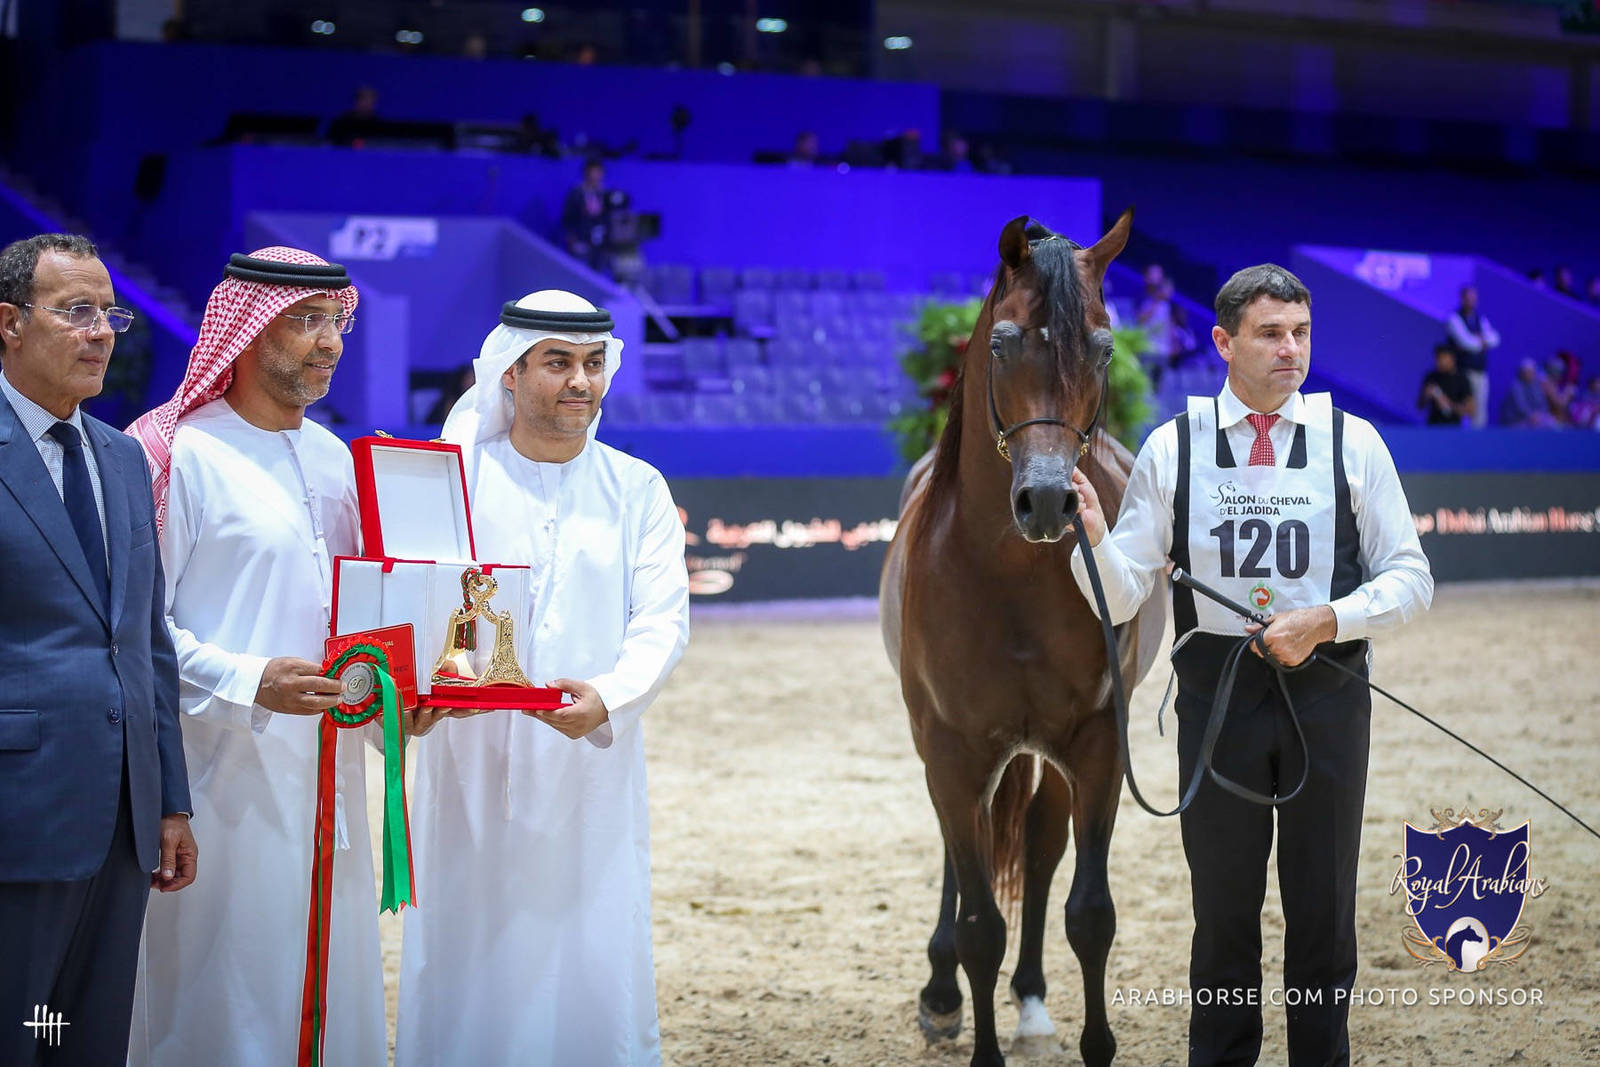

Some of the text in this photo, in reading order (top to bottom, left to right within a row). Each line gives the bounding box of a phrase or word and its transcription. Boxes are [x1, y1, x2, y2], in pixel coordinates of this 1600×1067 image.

[1210, 480, 1312, 507] SALON DU CHEVAL
[1240, 506, 1281, 516] JADIDA
[1209, 518, 1310, 579] 120
